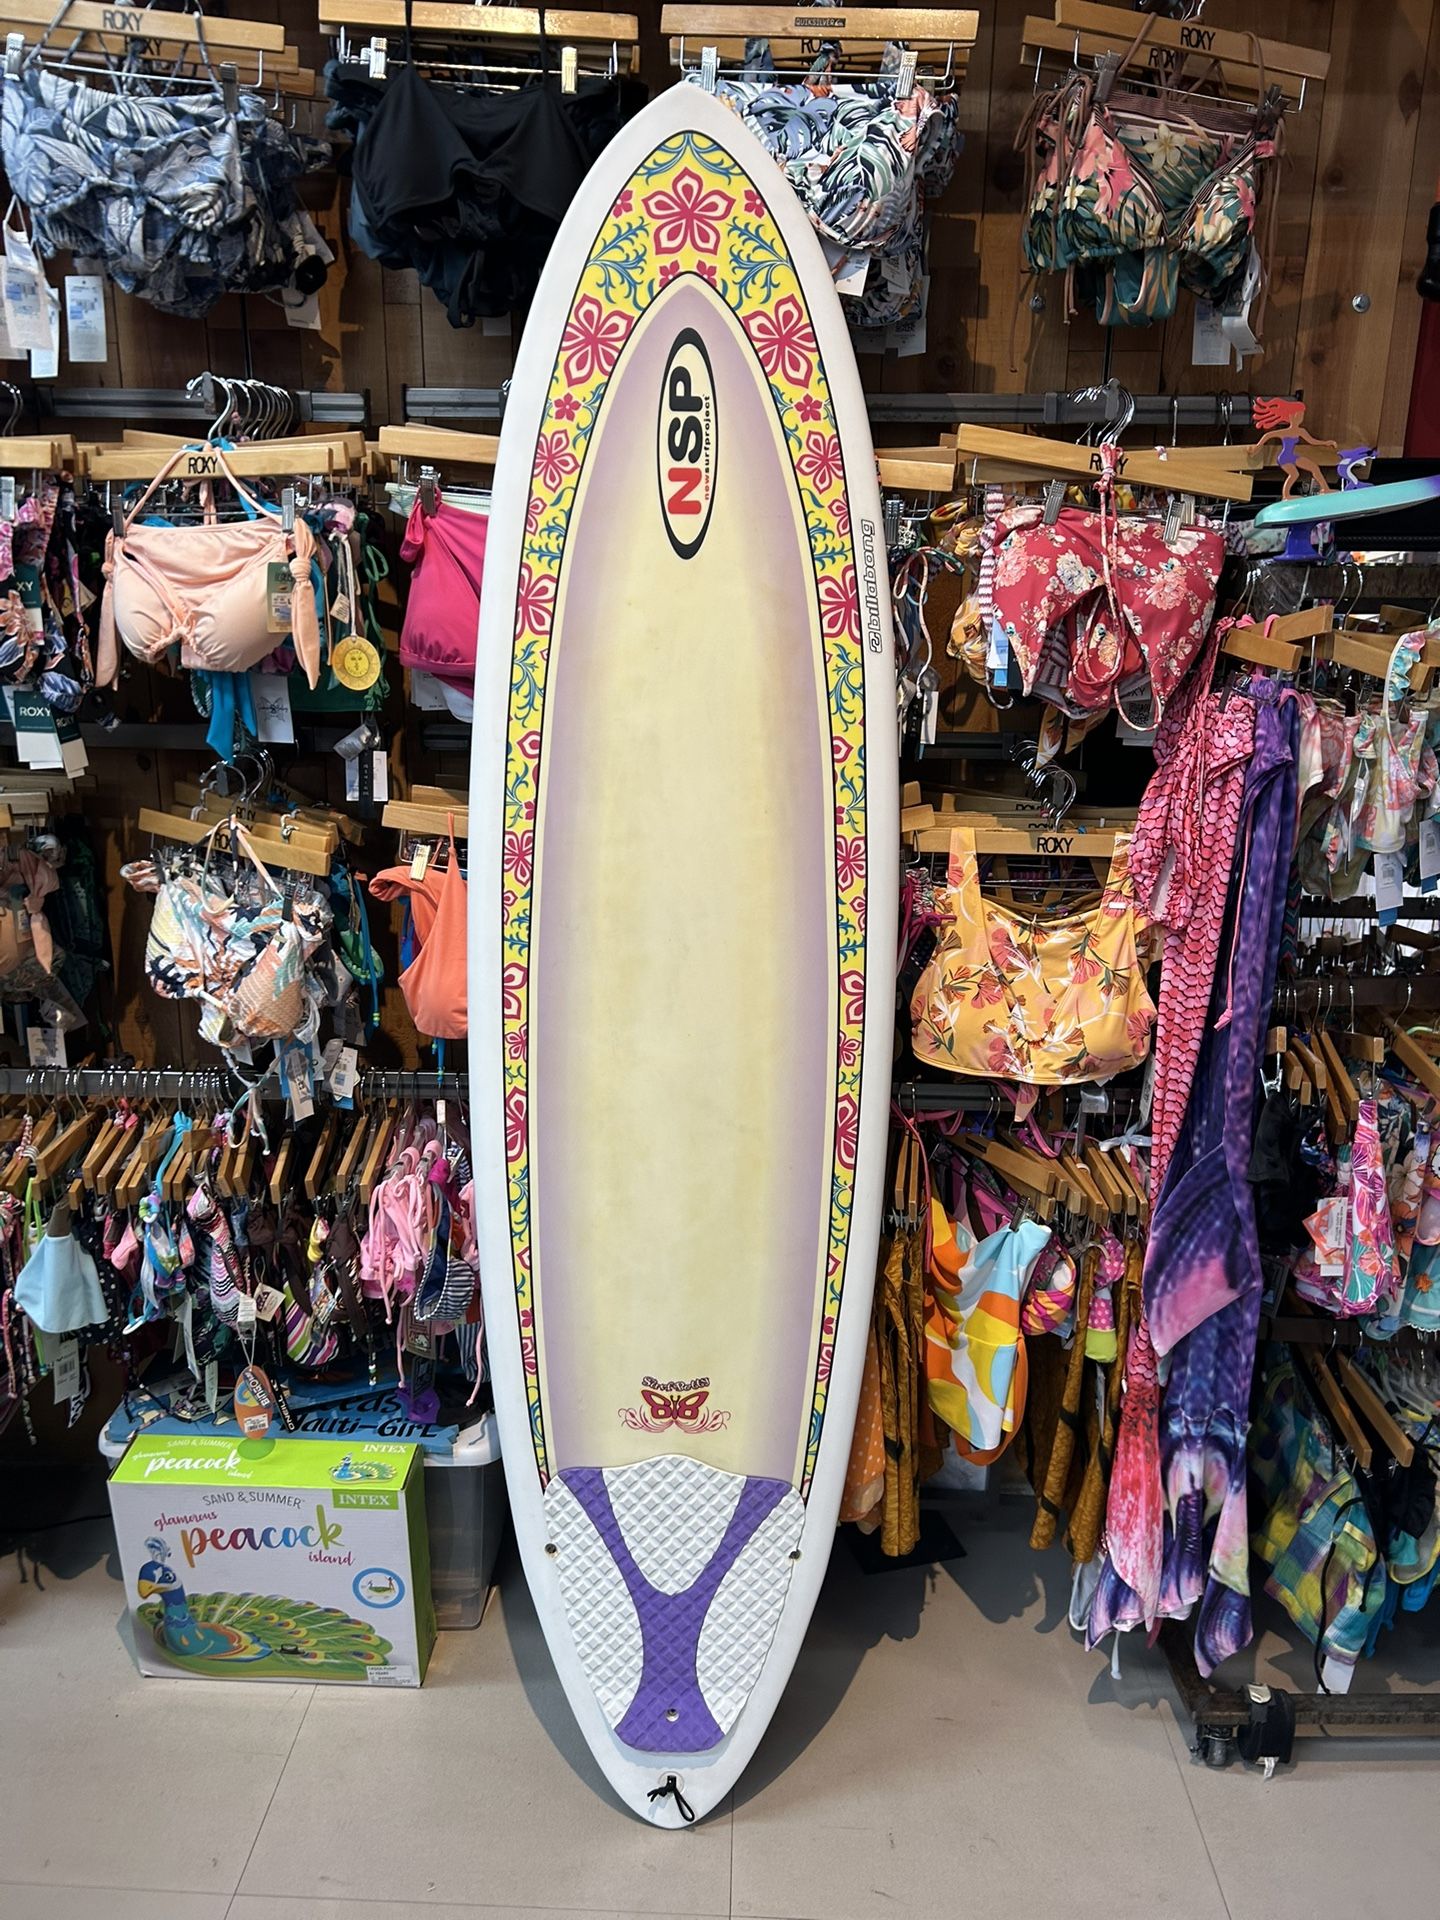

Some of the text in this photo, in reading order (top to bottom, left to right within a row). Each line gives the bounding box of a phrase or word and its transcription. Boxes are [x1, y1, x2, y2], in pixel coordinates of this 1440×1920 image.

[102, 10, 143, 31] ROXY
[796, 18, 834, 27] QUIKSILVER
[1180, 27, 1216, 51] ROXY
[668, 366, 703, 514] NSP
[188, 456, 217, 474] ROXY
[1089, 453, 1128, 475] RY
[861, 519, 880, 632] billabong
[19, 706, 51, 717] ROXY
[56, 715, 75, 728] ROXY
[1036, 836, 1073, 853] ROXY
[362, 1444, 407, 1454] INTEX
[144, 1449, 241, 1478] peacock
[202, 1491, 302, 1509] SAND & SUMMER
[338, 1494, 391, 1506] INTEX
[154, 1510, 218, 1531] glamorous
[181, 1504, 345, 1568] peacock
[308, 1550, 355, 1566] island
